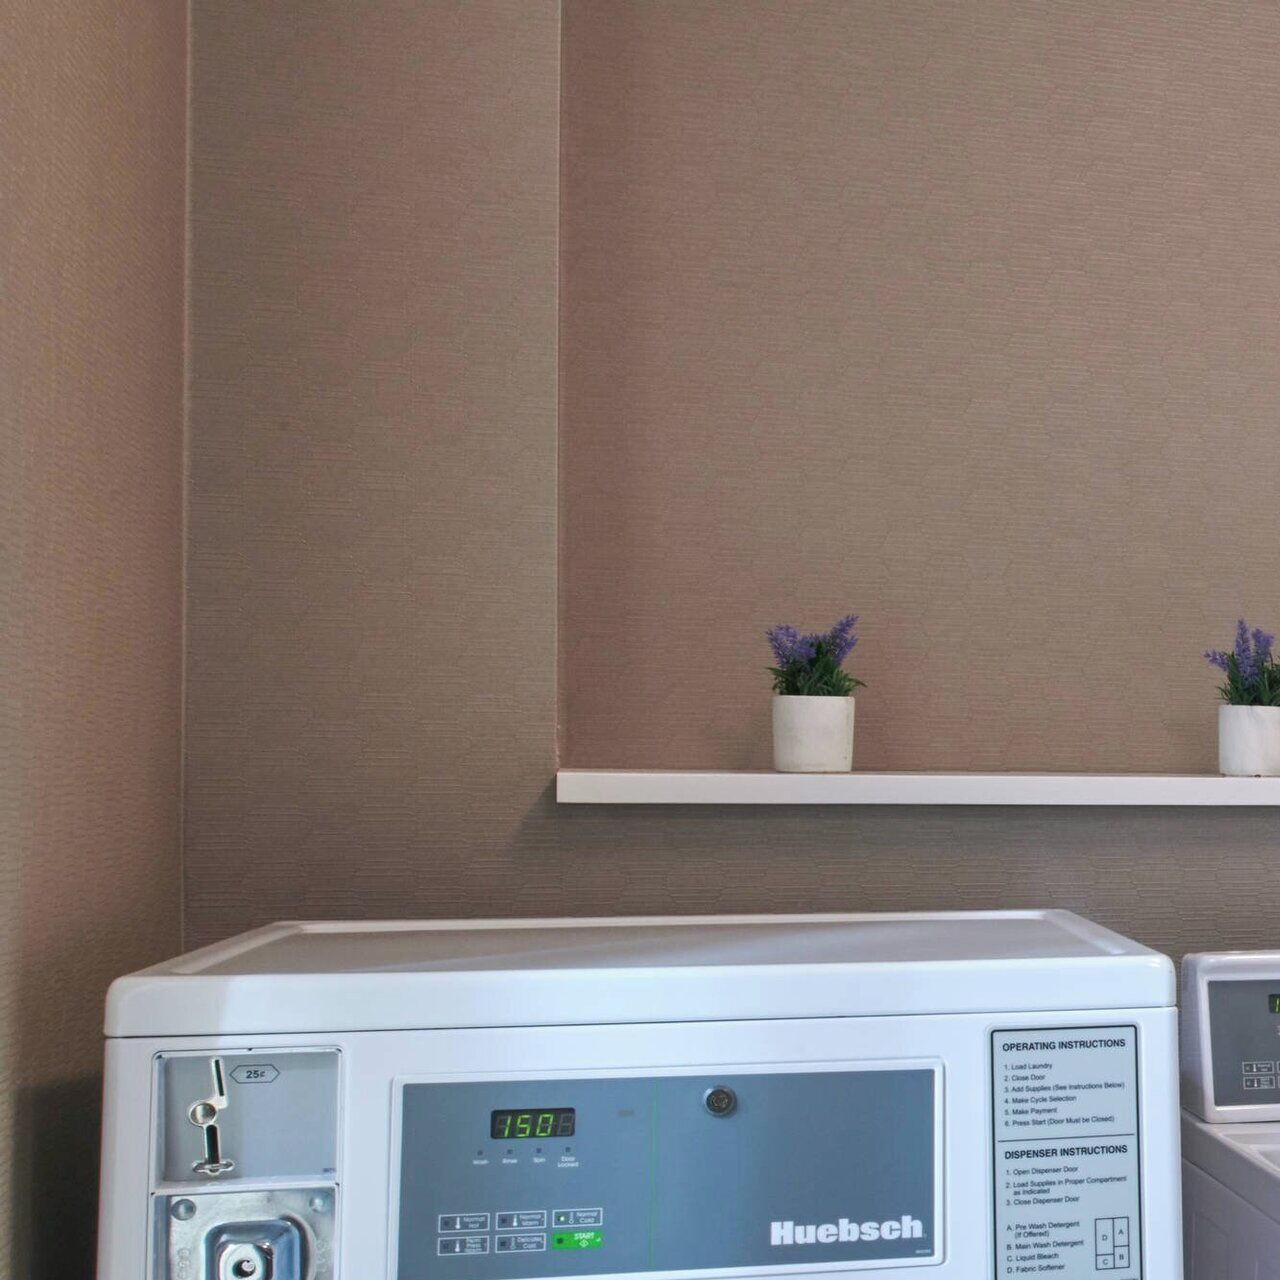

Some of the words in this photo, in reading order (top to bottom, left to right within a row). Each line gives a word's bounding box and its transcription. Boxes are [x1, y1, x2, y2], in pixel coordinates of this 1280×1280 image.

[1002, 1041, 1056, 1052] OPERATING
[1058, 1038, 1126, 1050] INSTRUCTIONS
[1026, 1085, 1051, 1093] Supplies
[1052, 1084, 1067, 1092] (See
[1069, 1082, 1103, 1090] Instructions
[1030, 1096, 1047, 1104] Cycle
[1030, 1107, 1057, 1115] Payment
[504, 1114, 554, 1137] 150
[1012, 1119, 1029, 1127] Press
[1031, 1118, 1046, 1126] Start
[1047, 1118, 1064, 1126] (Door
[1091, 1115, 1115, 1123] Closed)
[1005, 1148, 1058, 1160] DISPENSER
[1060, 1145, 1128, 1156] INSTRUCTIONS
[1013, 1168, 1030, 1176] Open
[1031, 1167, 1061, 1175] Dispenser
[1030, 1179, 1056, 1188] Supplies
[1065, 1178, 1085, 1186] Proper
[1086, 1176, 1127, 1184] Compartment
[1033, 1197, 1063, 1205] Dispenser
[1028, 1222, 1047, 1230] Wash
[1048, 1221, 1080, 1229] Detergent
[770, 1215, 923, 1246] Huebsch
[1053, 1240, 1084, 1248] Detergent
[1016, 1254, 1035, 1262] Liquid
[1016, 1265, 1038, 1273] Fabric
